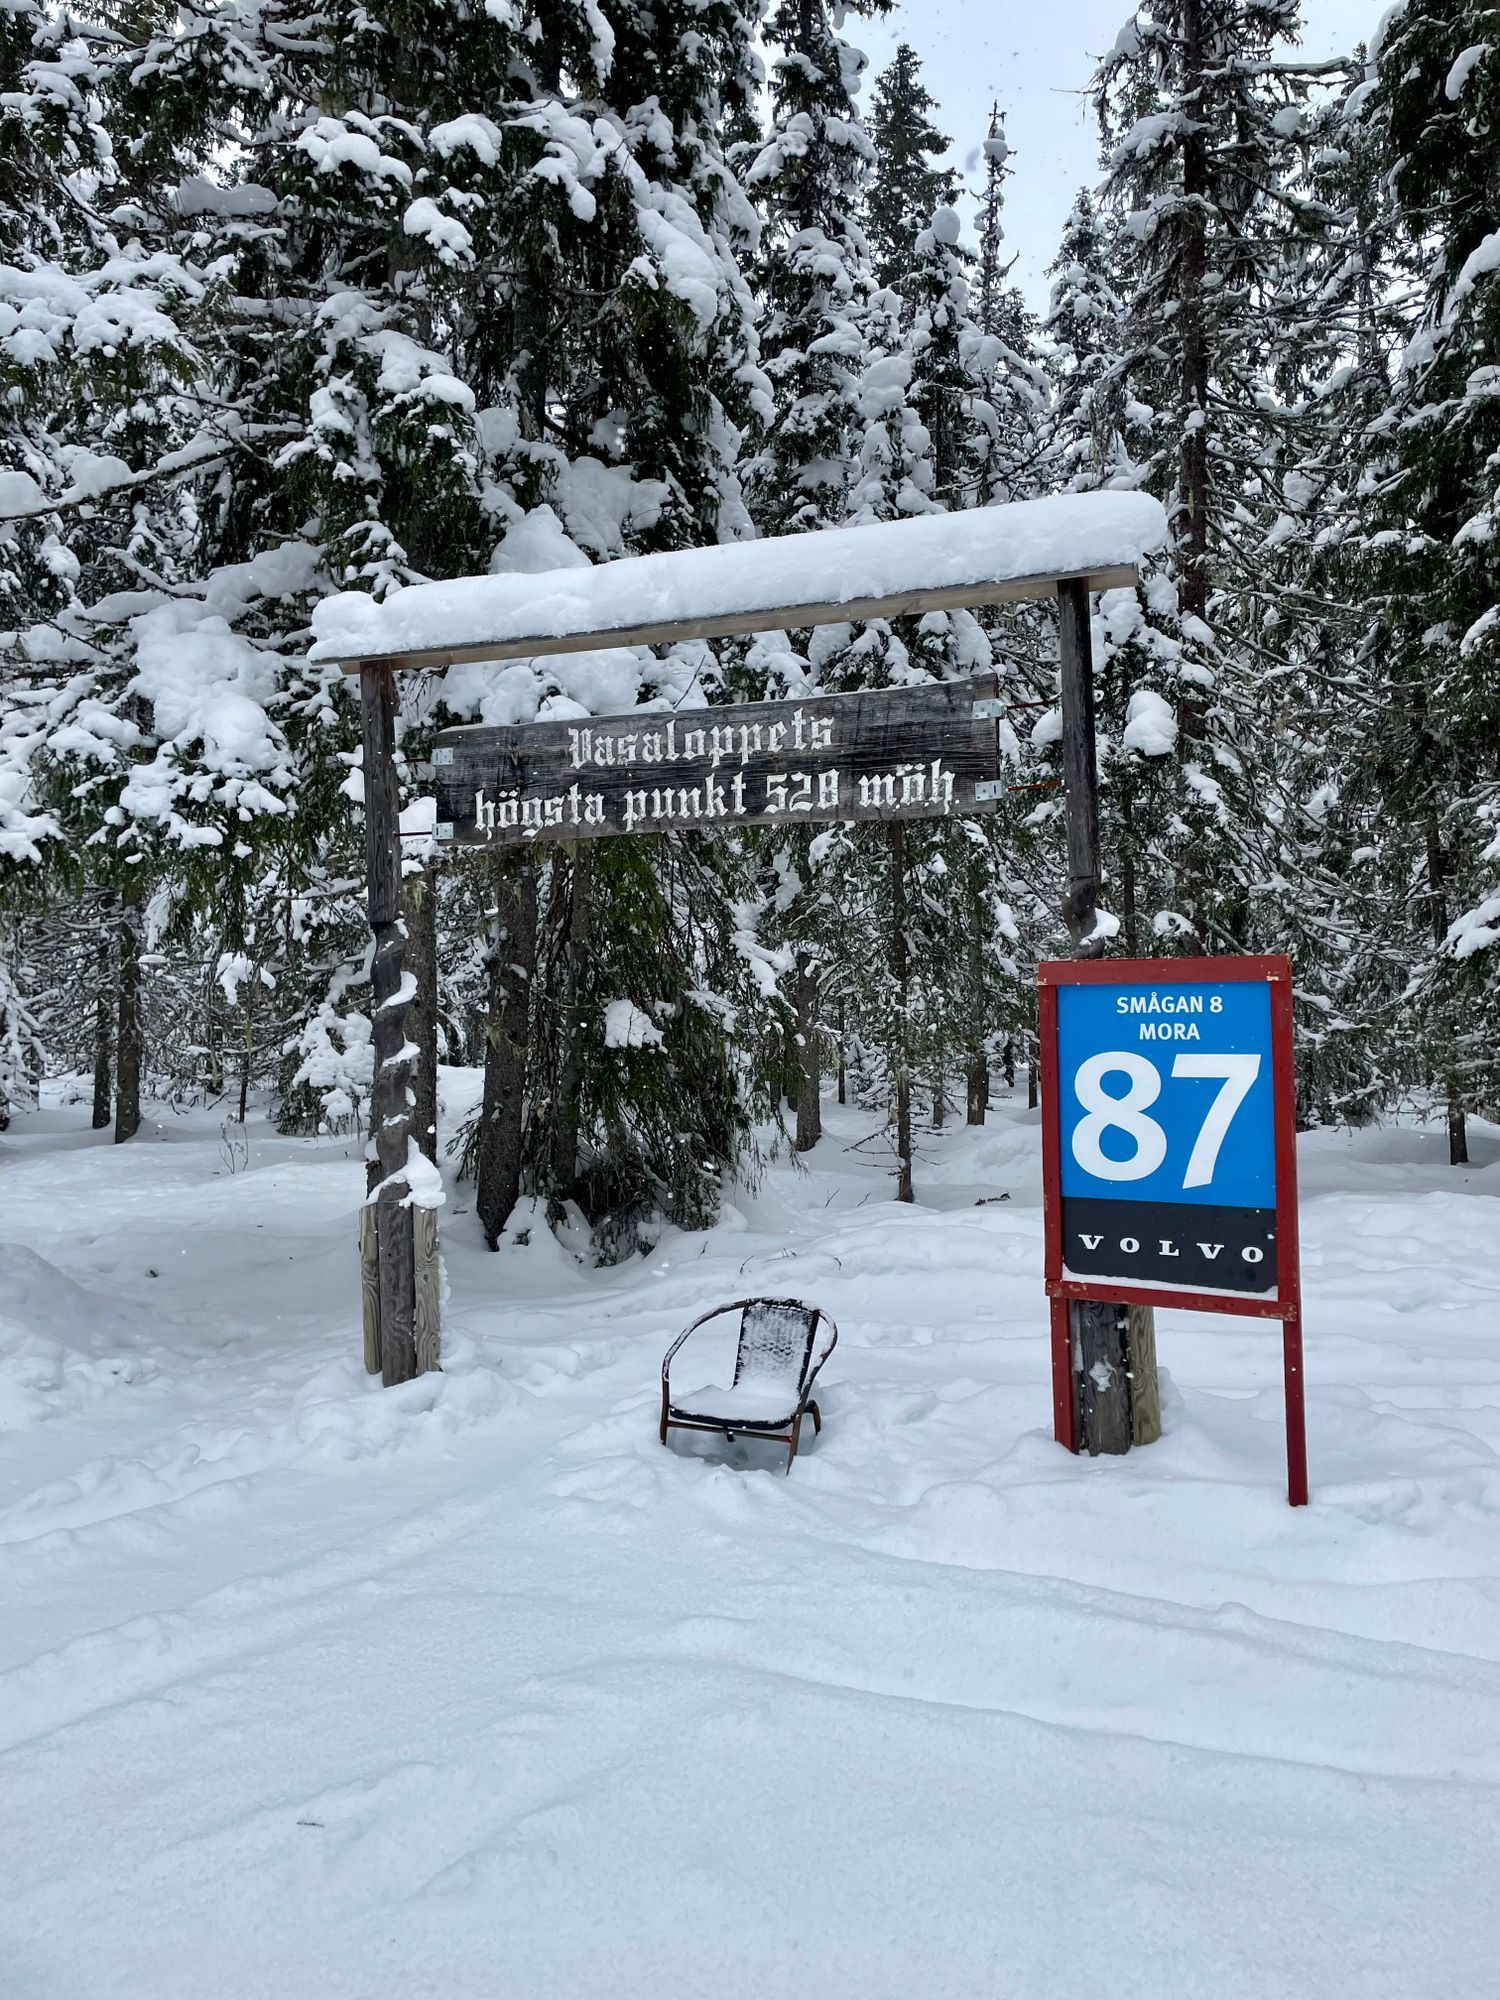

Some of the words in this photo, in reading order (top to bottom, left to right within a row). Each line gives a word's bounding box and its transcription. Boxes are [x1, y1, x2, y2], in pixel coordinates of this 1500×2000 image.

[567, 706, 835, 770] Vasaloppets
[474, 782, 607, 842] högsta
[622, 771, 748, 832] punkt
[763, 768, 840, 814] 528
[1116, 991, 1203, 1014] SMÅGAN
[1209, 996, 1224, 1014] 8
[1138, 1023, 1201, 1041] MORA
[1071, 1051, 1262, 1190] 87
[1078, 1233, 1264, 1264] VOLVO
